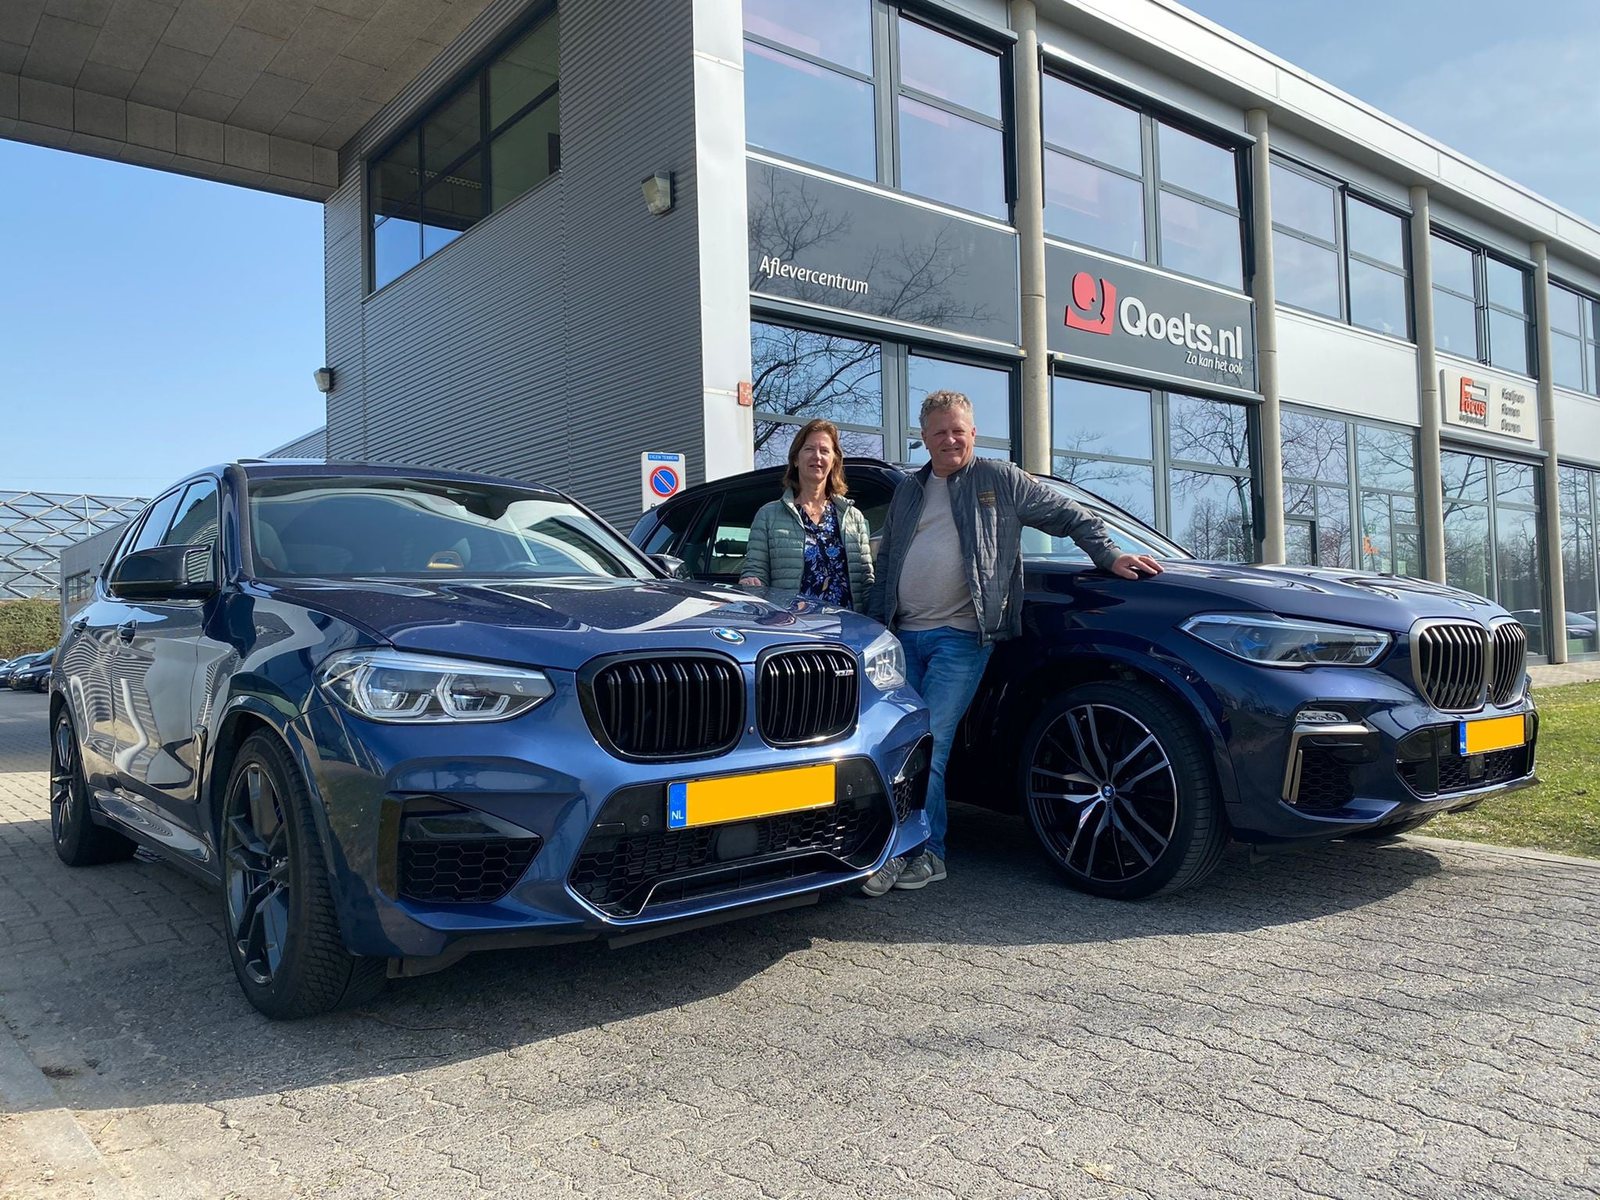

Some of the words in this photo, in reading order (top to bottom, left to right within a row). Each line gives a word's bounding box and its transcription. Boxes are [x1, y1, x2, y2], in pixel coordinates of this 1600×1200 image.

[759, 255, 869, 294] Aflevercentrum
[1119, 296, 1243, 360] Qoets.nl
[1185, 351, 1198, 365] Zo
[1198, 353, 1214, 370] kan
[1214, 356, 1227, 372] het
[1228, 361, 1243, 375] ook
[671, 810, 684, 820] NL
